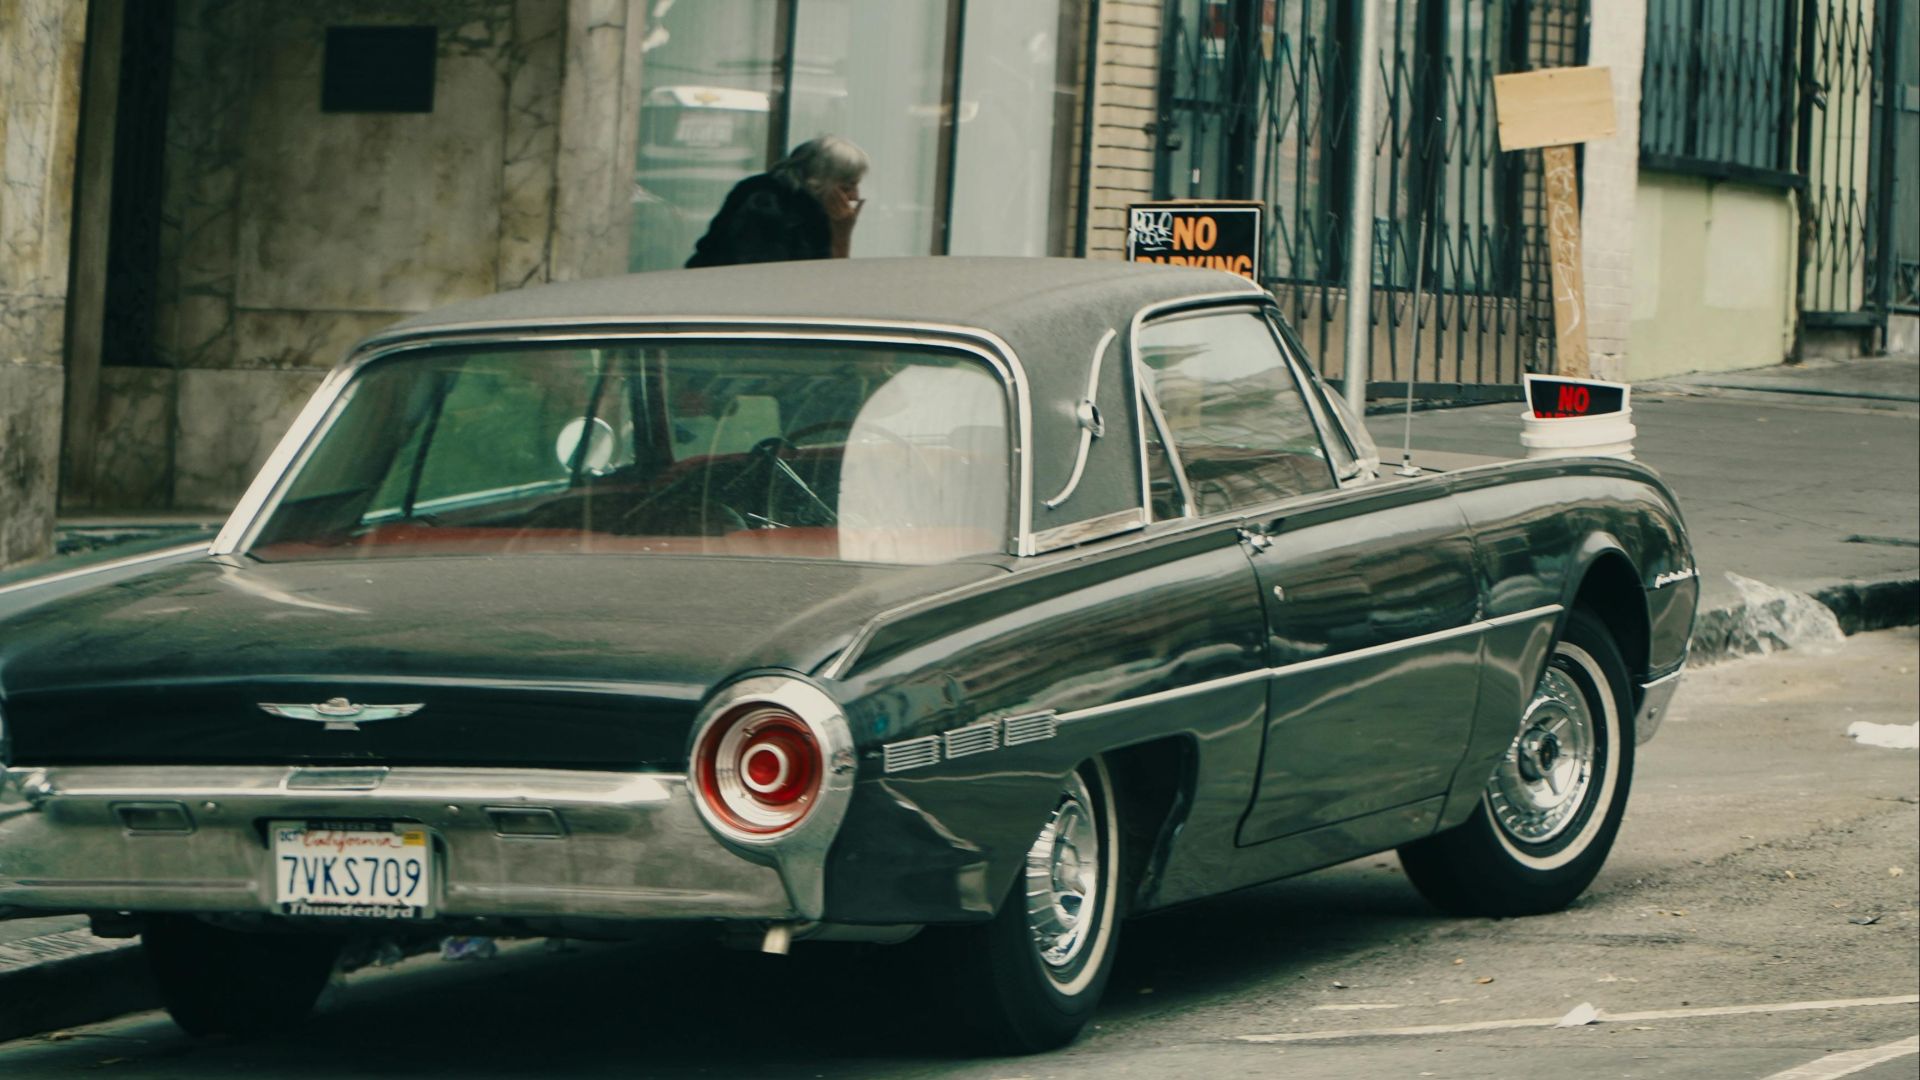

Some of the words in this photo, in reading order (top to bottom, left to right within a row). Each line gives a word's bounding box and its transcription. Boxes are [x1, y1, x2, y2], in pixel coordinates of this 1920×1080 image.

[1173, 216, 1217, 251] NO
[1558, 385, 1590, 412] NO
[303, 830, 401, 852] California
[282, 856, 420, 897] 7VKS709
[291, 904, 414, 918] Thunderbird
